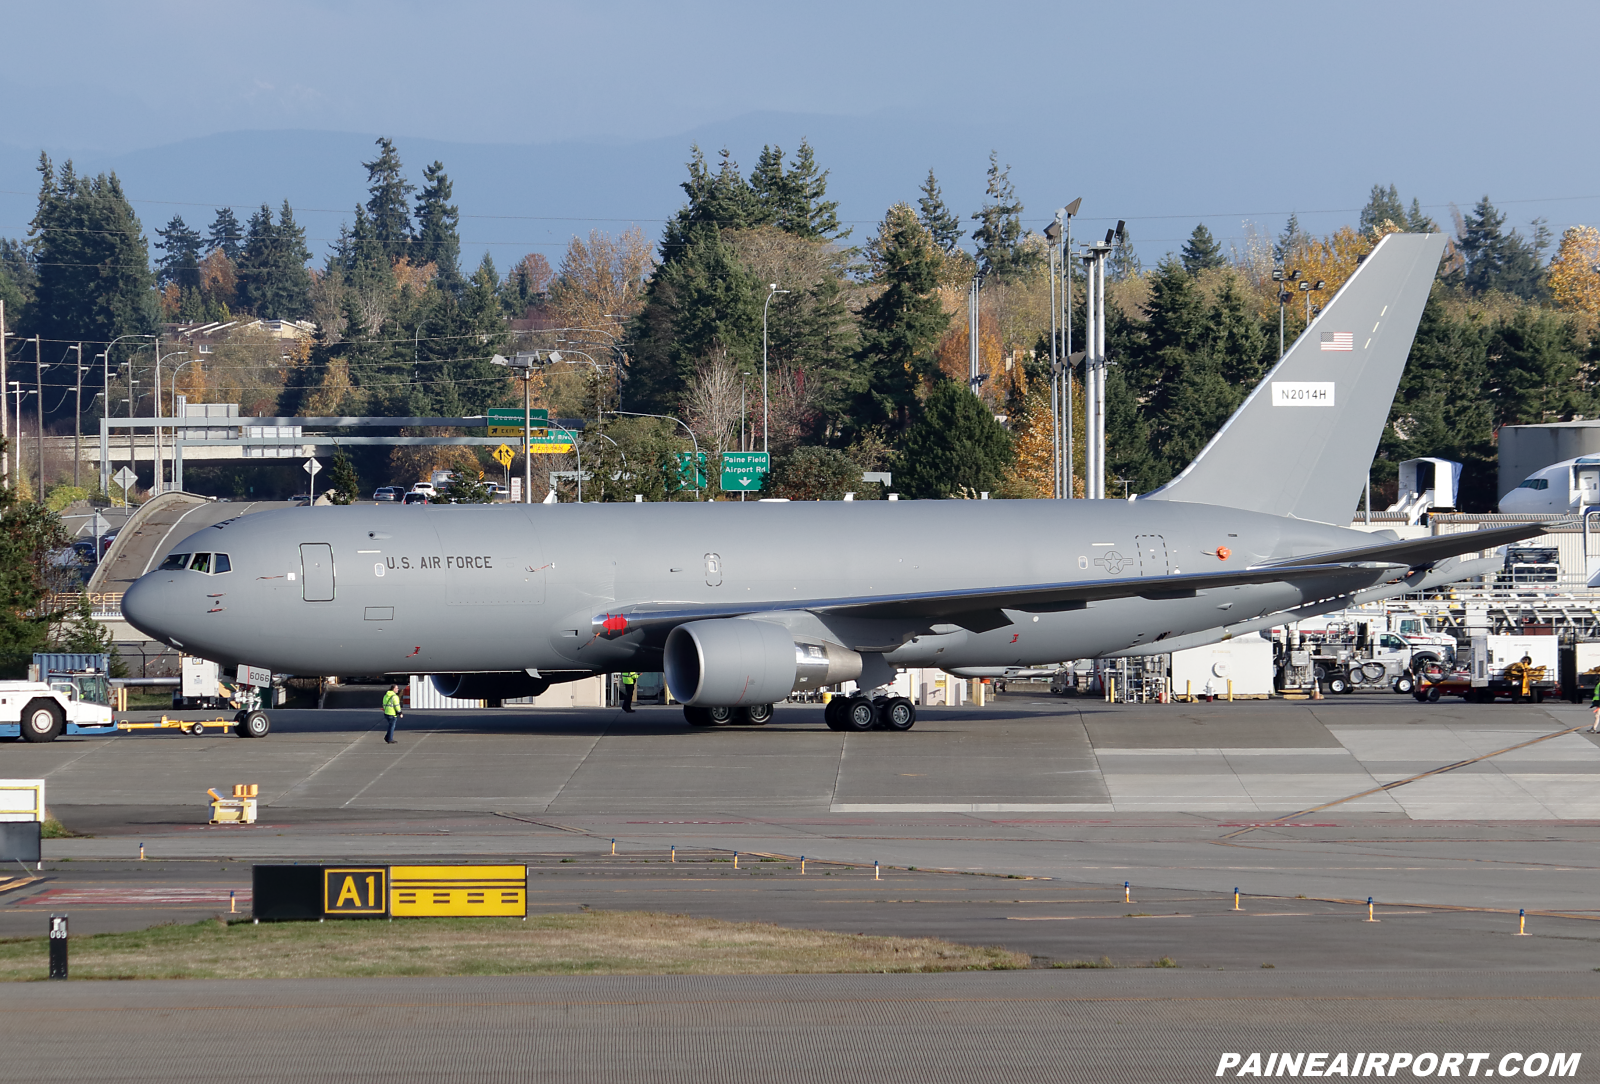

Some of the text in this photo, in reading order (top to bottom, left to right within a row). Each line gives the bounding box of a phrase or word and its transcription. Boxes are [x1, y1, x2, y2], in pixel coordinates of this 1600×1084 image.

[1281, 389, 1327, 400] N2014H
[725, 466, 753, 474] Airport
[386, 556, 493, 570] U.S. AIR FORCE
[249, 671, 270, 683] 6066
[336, 875, 375, 907] A1
